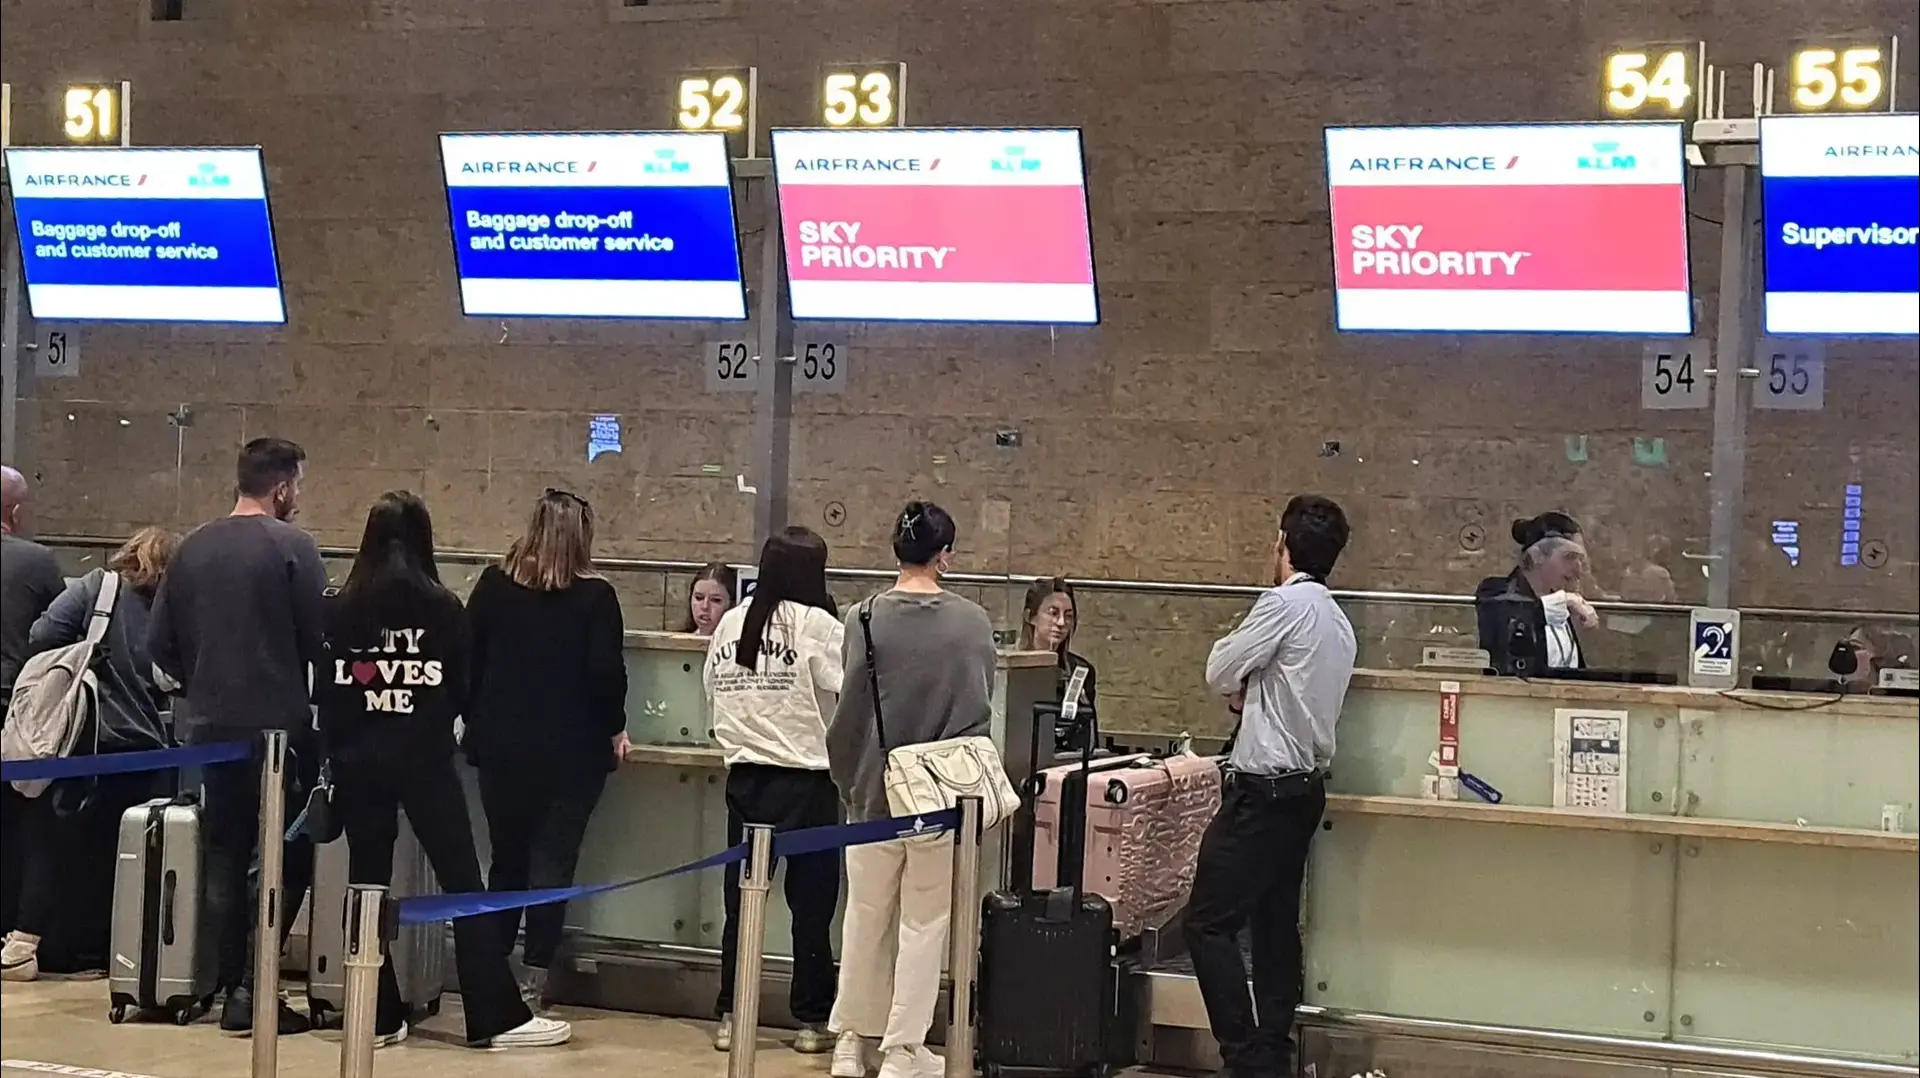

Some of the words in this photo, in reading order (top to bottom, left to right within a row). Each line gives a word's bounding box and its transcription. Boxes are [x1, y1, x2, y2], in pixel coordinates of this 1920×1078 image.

[1609, 51, 1690, 109] 54
[1796, 49, 1882, 106] 55
[65, 88, 113, 138] 51
[679, 77, 743, 128] 52
[824, 73, 893, 125] 53
[32, 220, 107, 239] Baggage
[111, 221, 181, 239] drop-off
[467, 211, 550, 231] Baggage
[555, 210, 633, 230] drop-off
[799, 221, 861, 243] SKY
[1782, 222, 1918, 249] Supervisor
[36, 241, 67, 258] and
[71, 243, 152, 259] customer
[156, 243, 218, 260] service
[470, 233, 505, 250] and
[509, 235, 600, 251] customer
[604, 234, 674, 251] service
[1352, 225, 1423, 249] SKY
[47, 332, 67, 364] 51
[717, 343, 748, 379] 52
[803, 343, 836, 380] 53
[1654, 353, 1695, 395] 54
[1768, 354, 1809, 395] 55
[349, 627, 425, 654] TY
[364, 689, 414, 713] ME
